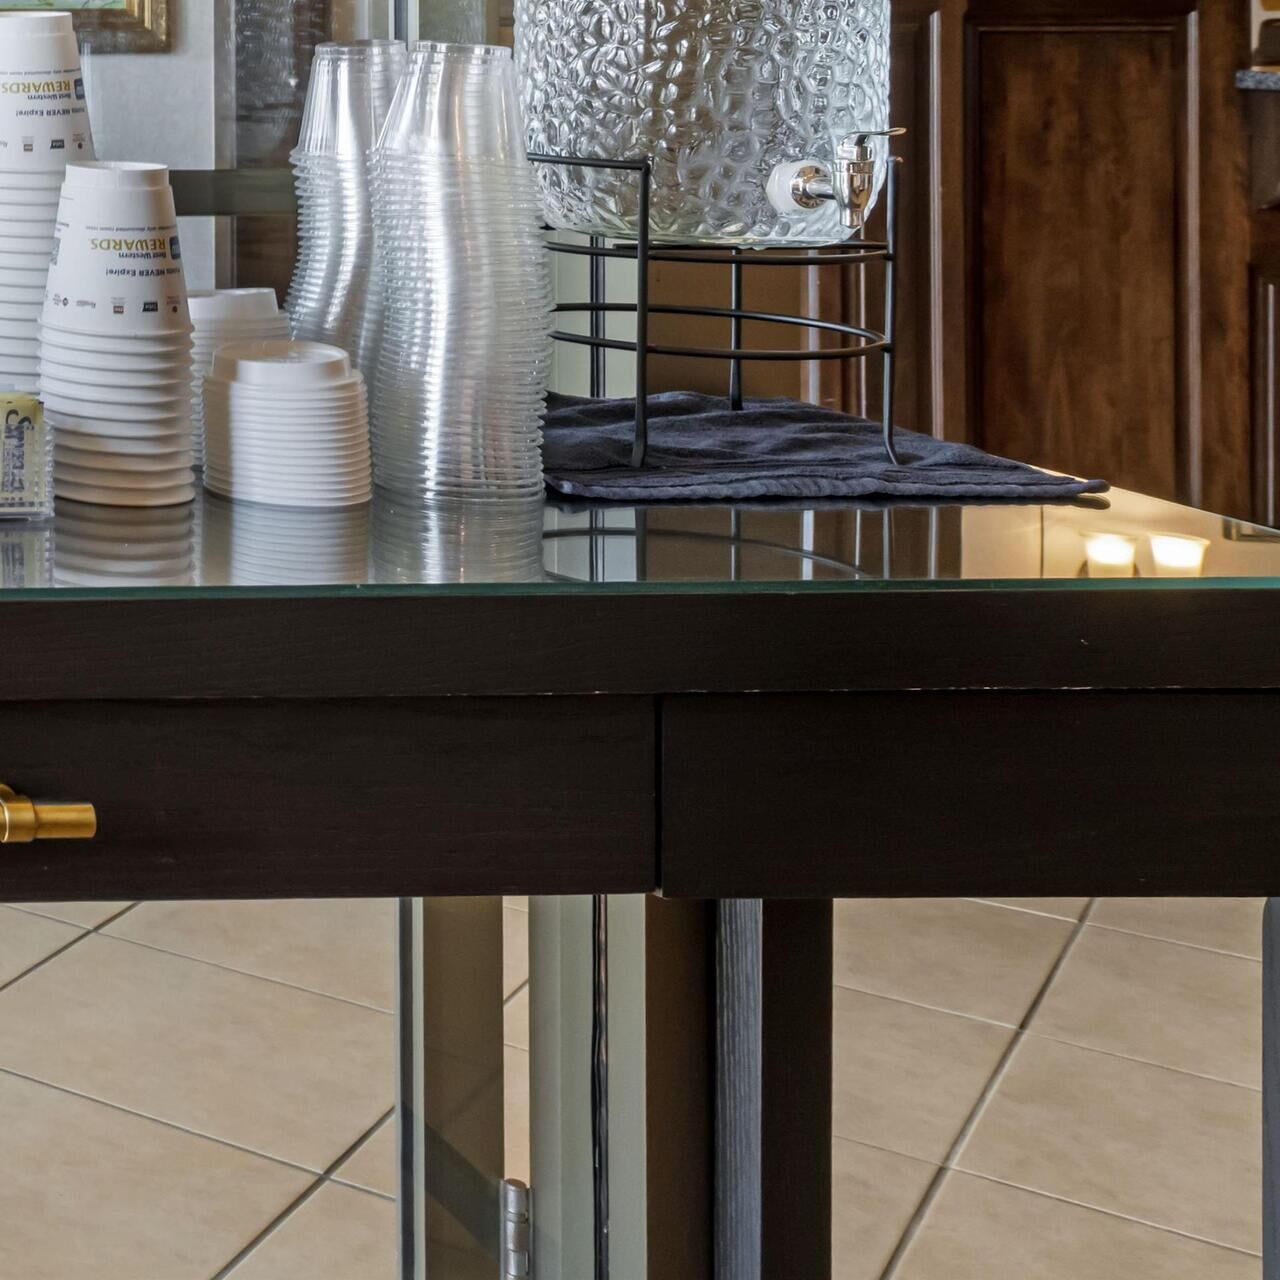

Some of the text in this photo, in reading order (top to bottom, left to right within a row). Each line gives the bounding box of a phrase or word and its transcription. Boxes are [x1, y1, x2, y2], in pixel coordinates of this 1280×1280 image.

[1, 80, 71, 94] REWARDS
[91, 237, 167, 251] REWARDS
[118, 251, 151, 259] Western
